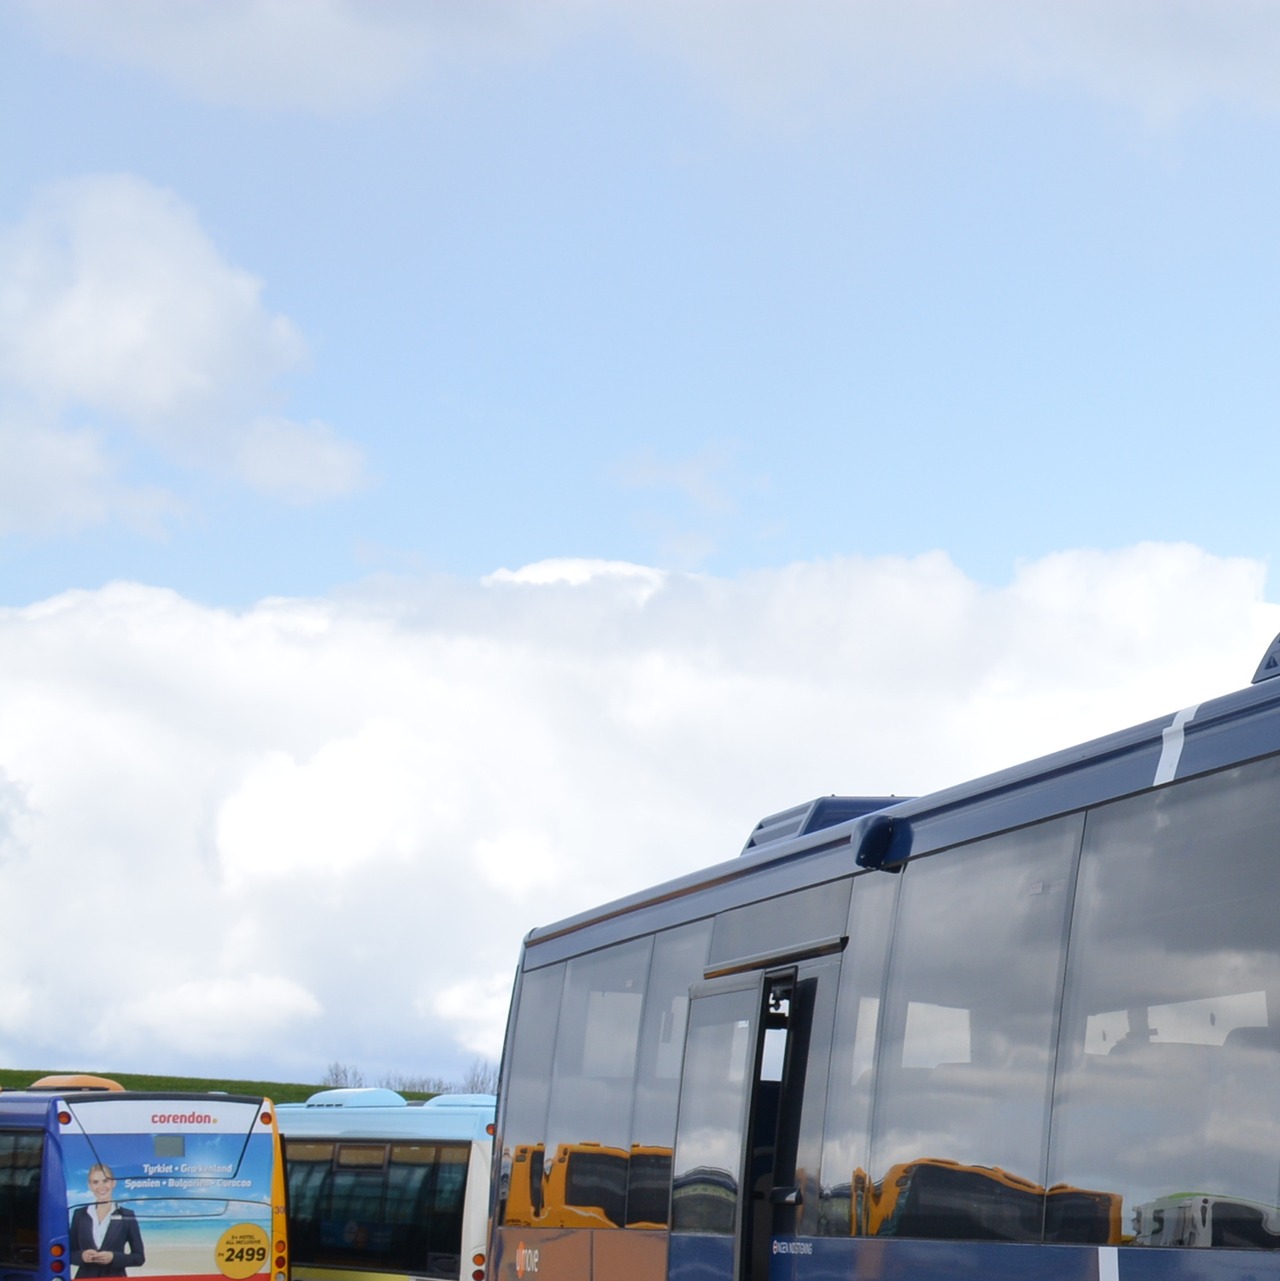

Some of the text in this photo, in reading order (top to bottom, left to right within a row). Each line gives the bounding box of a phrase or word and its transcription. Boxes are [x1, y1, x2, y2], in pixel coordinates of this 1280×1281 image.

[143, 1164, 173, 1174] Tyrkiet
[125, 1179, 160, 1190] Spanien
[225, 1247, 266, 1262] 2499
